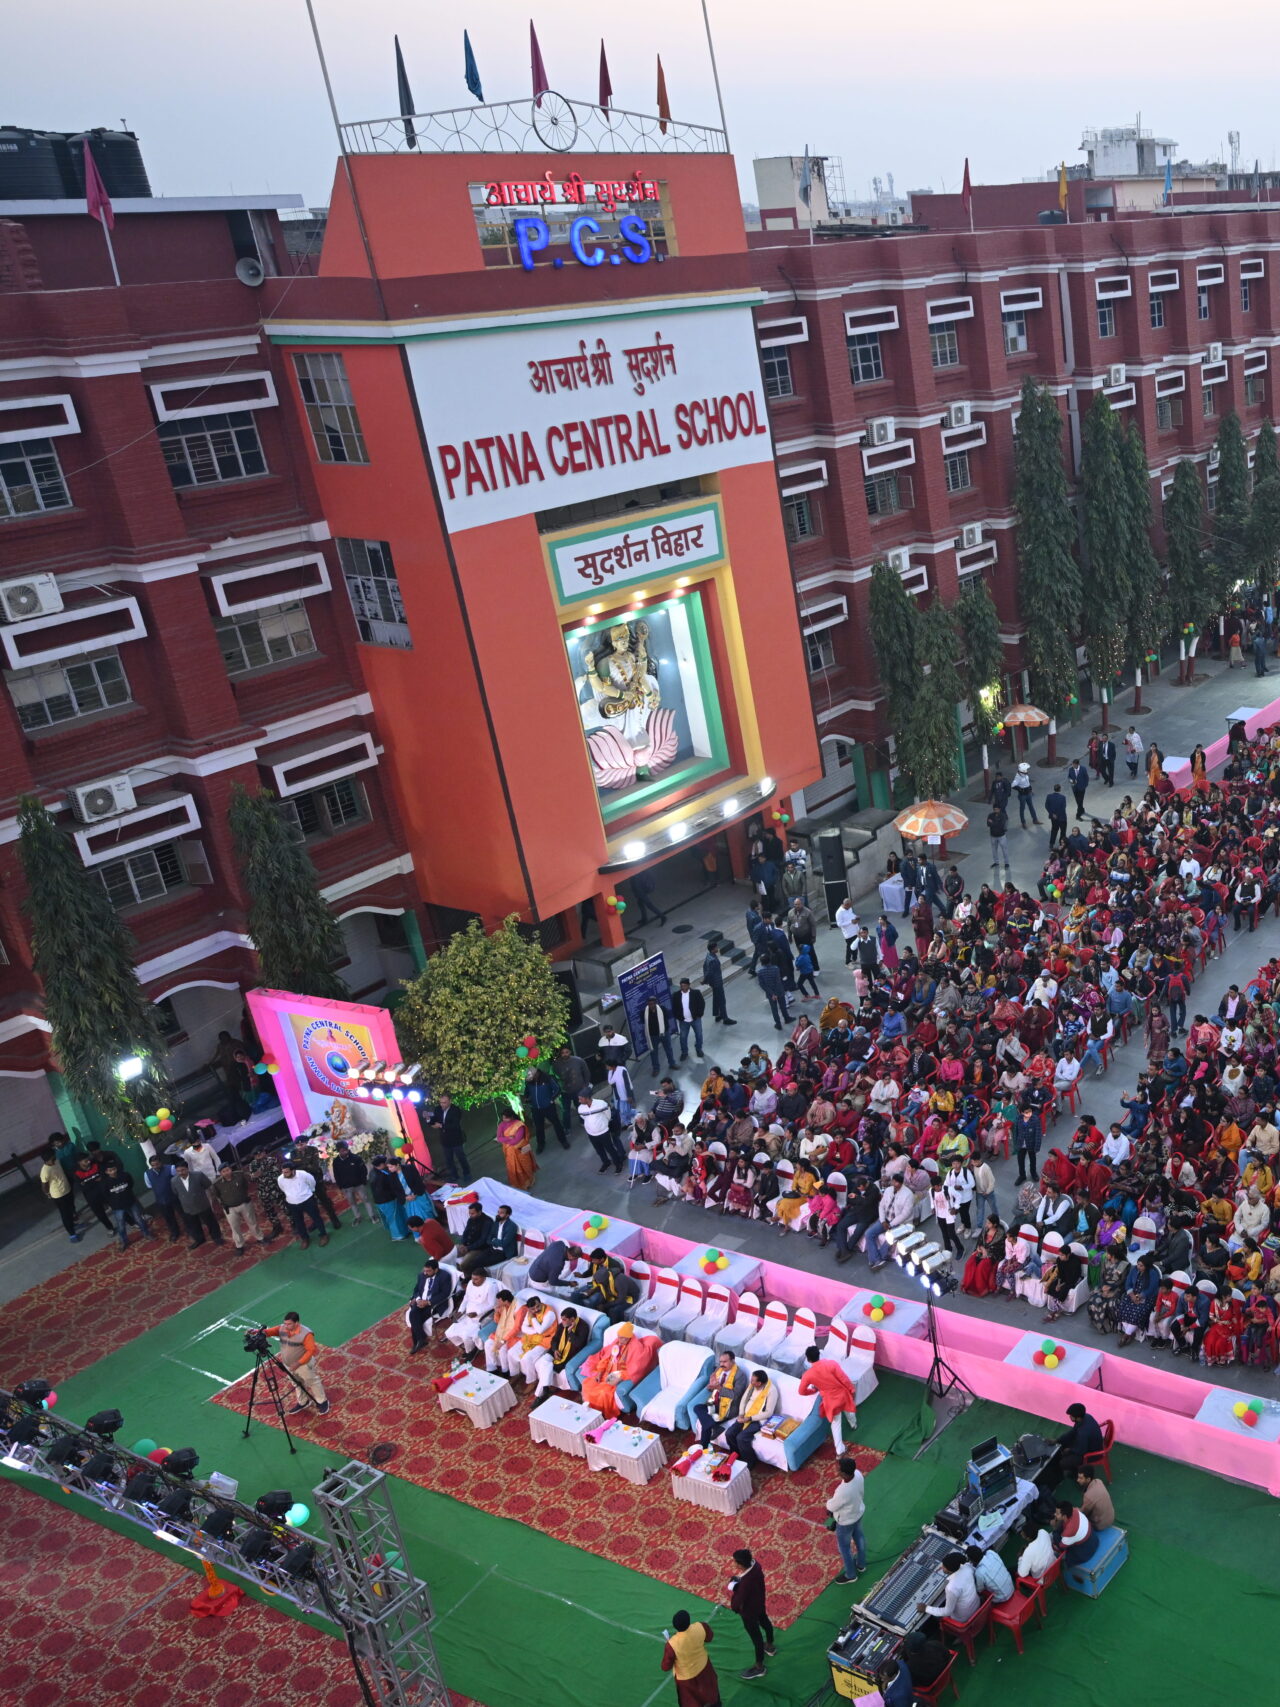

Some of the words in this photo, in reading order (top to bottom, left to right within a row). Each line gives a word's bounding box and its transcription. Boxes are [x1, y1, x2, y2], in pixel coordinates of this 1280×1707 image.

[485, 171, 557, 206] आचार्य
[562, 172, 586, 204] श्री
[593, 170, 660, 213] सुदर्शन
[622, 331, 677, 396] सुदर्शन
[437, 431, 545, 499] PATNA
[545, 408, 671, 476] CENTRAL
[674, 390, 767, 450] SCHOOL
[574, 534, 650, 585] सुदर्शन
[651, 524, 704, 561] विहार
[302, 1026, 313, 1050] PATNA
[310, 1020, 342, 1033] CENTRAL
[344, 1030, 368, 1060] SCHOOL
[306, 1056, 330, 1087] ANNUAL
[331, 1082, 345, 1095] DAY
